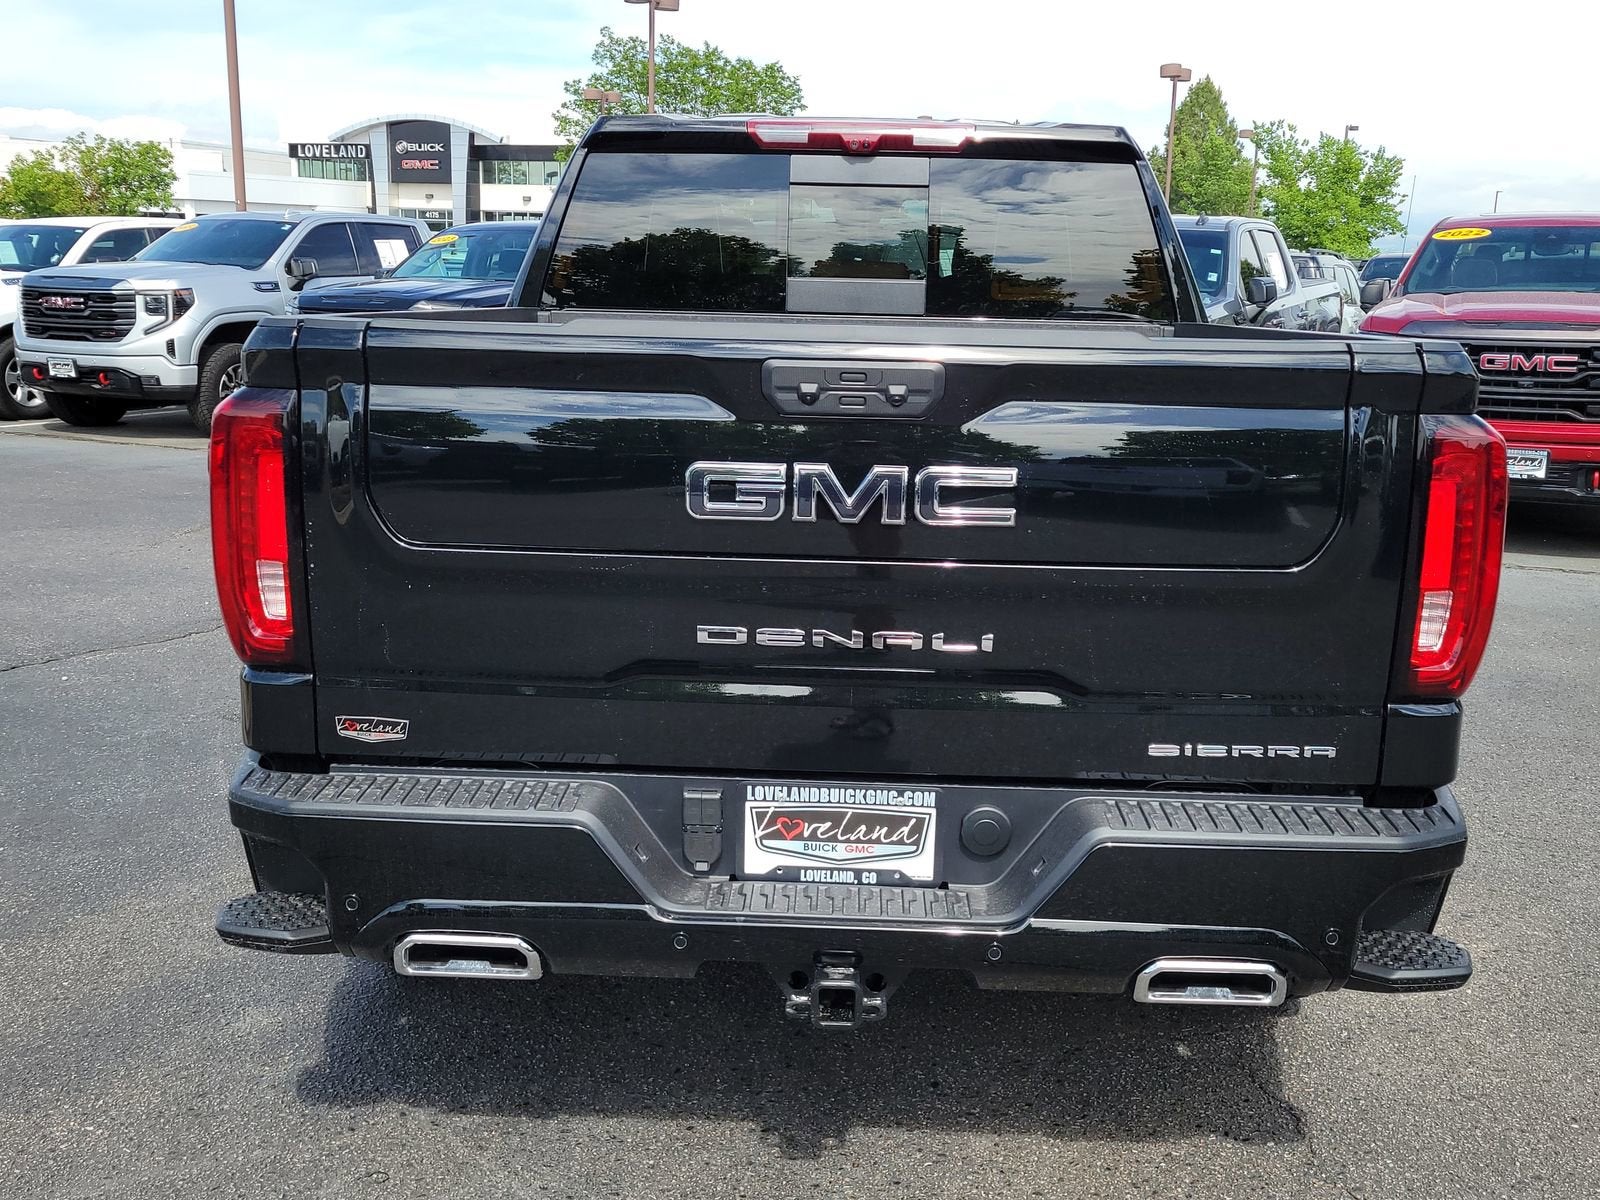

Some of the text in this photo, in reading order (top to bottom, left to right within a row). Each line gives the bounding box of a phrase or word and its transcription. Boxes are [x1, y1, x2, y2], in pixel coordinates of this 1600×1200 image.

[297, 144, 366, 158] LOVELAND
[407, 143, 445, 151] BUICK
[401, 159, 439, 169] GMC
[1480, 353, 1579, 373] GMC
[685, 461, 1019, 528] GMC
[696, 624, 994, 653] DENALI
[1148, 743, 1337, 759] SIERRA
[746, 785, 936, 807] LOVELANDBUICKGMCCOM
[803, 842, 875, 854] BUICK GMC
[800, 869, 877, 884] LOVELAND, CO
